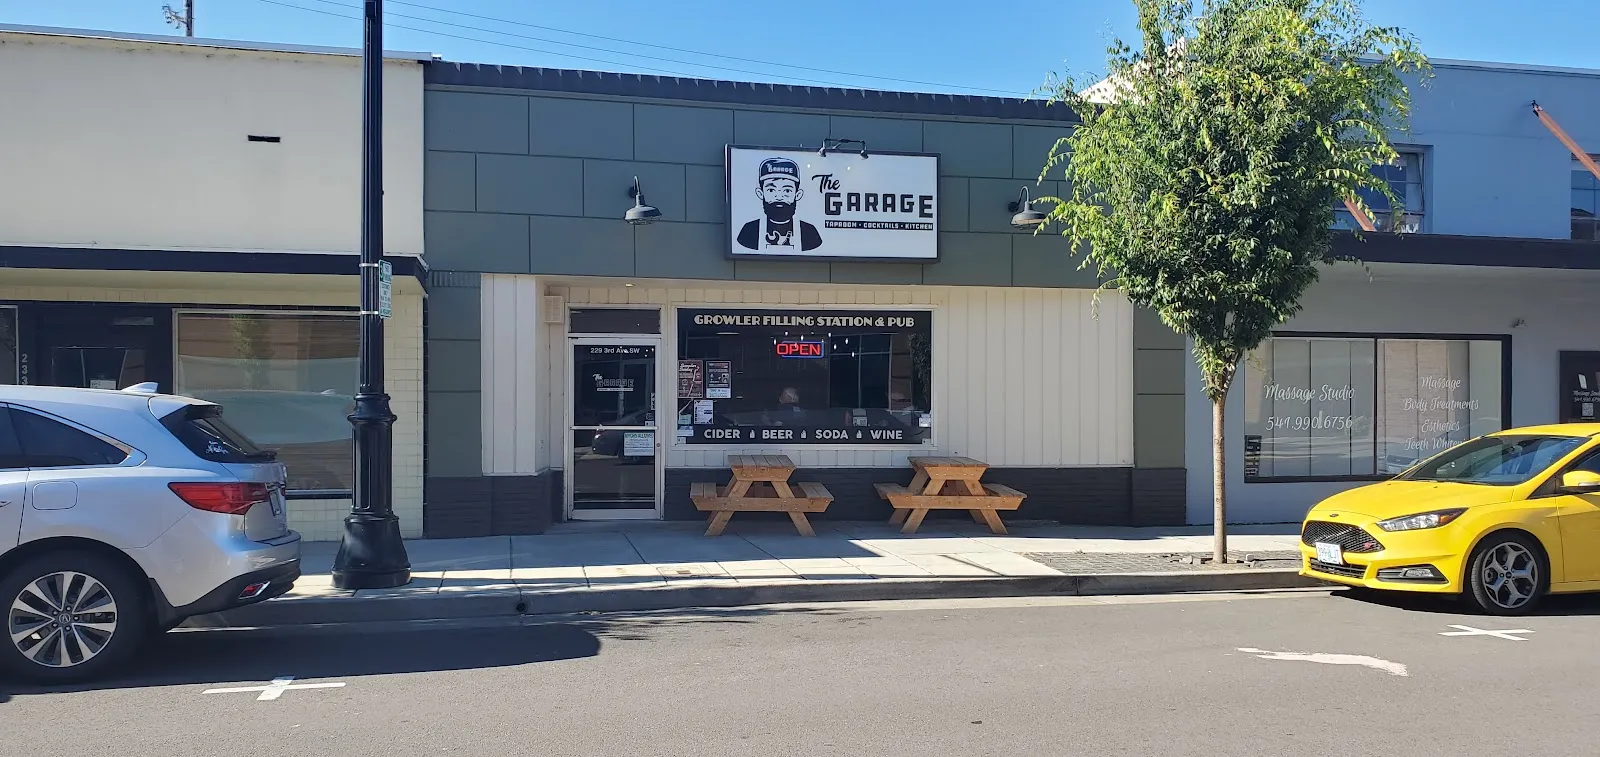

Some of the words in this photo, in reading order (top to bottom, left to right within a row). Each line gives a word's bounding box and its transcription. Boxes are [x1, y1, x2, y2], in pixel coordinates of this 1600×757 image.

[812, 173, 840, 193] The
[824, 192, 934, 218] GARAGE
[825, 220, 857, 228] TAPROOM
[863, 221, 899, 229] COCKTAILS
[694, 314, 761, 326] GROWLER
[763, 315, 815, 326] FILLING
[816, 316, 872, 327] STATION
[875, 317, 885, 327] &
[887, 317, 915, 327] PUB
[776, 343, 821, 356] OPEN
[1420, 376, 1461, 391] Massage
[1264, 384, 1316, 403] Massage
[1318, 384, 1355, 401] Studio
[1402, 397, 1428, 412] Body
[1429, 397, 1479, 412] Treatments
[1265, 415, 1353, 431] 541.990.6756
[1421, 418, 1460, 433] Esthetics
[703, 429, 741, 439] CIDER
[762, 429, 793, 440] BEER
[815, 429, 849, 440] SODA
[870, 430, 903, 440] WINE
[1404, 436, 1430, 451] Teeth
